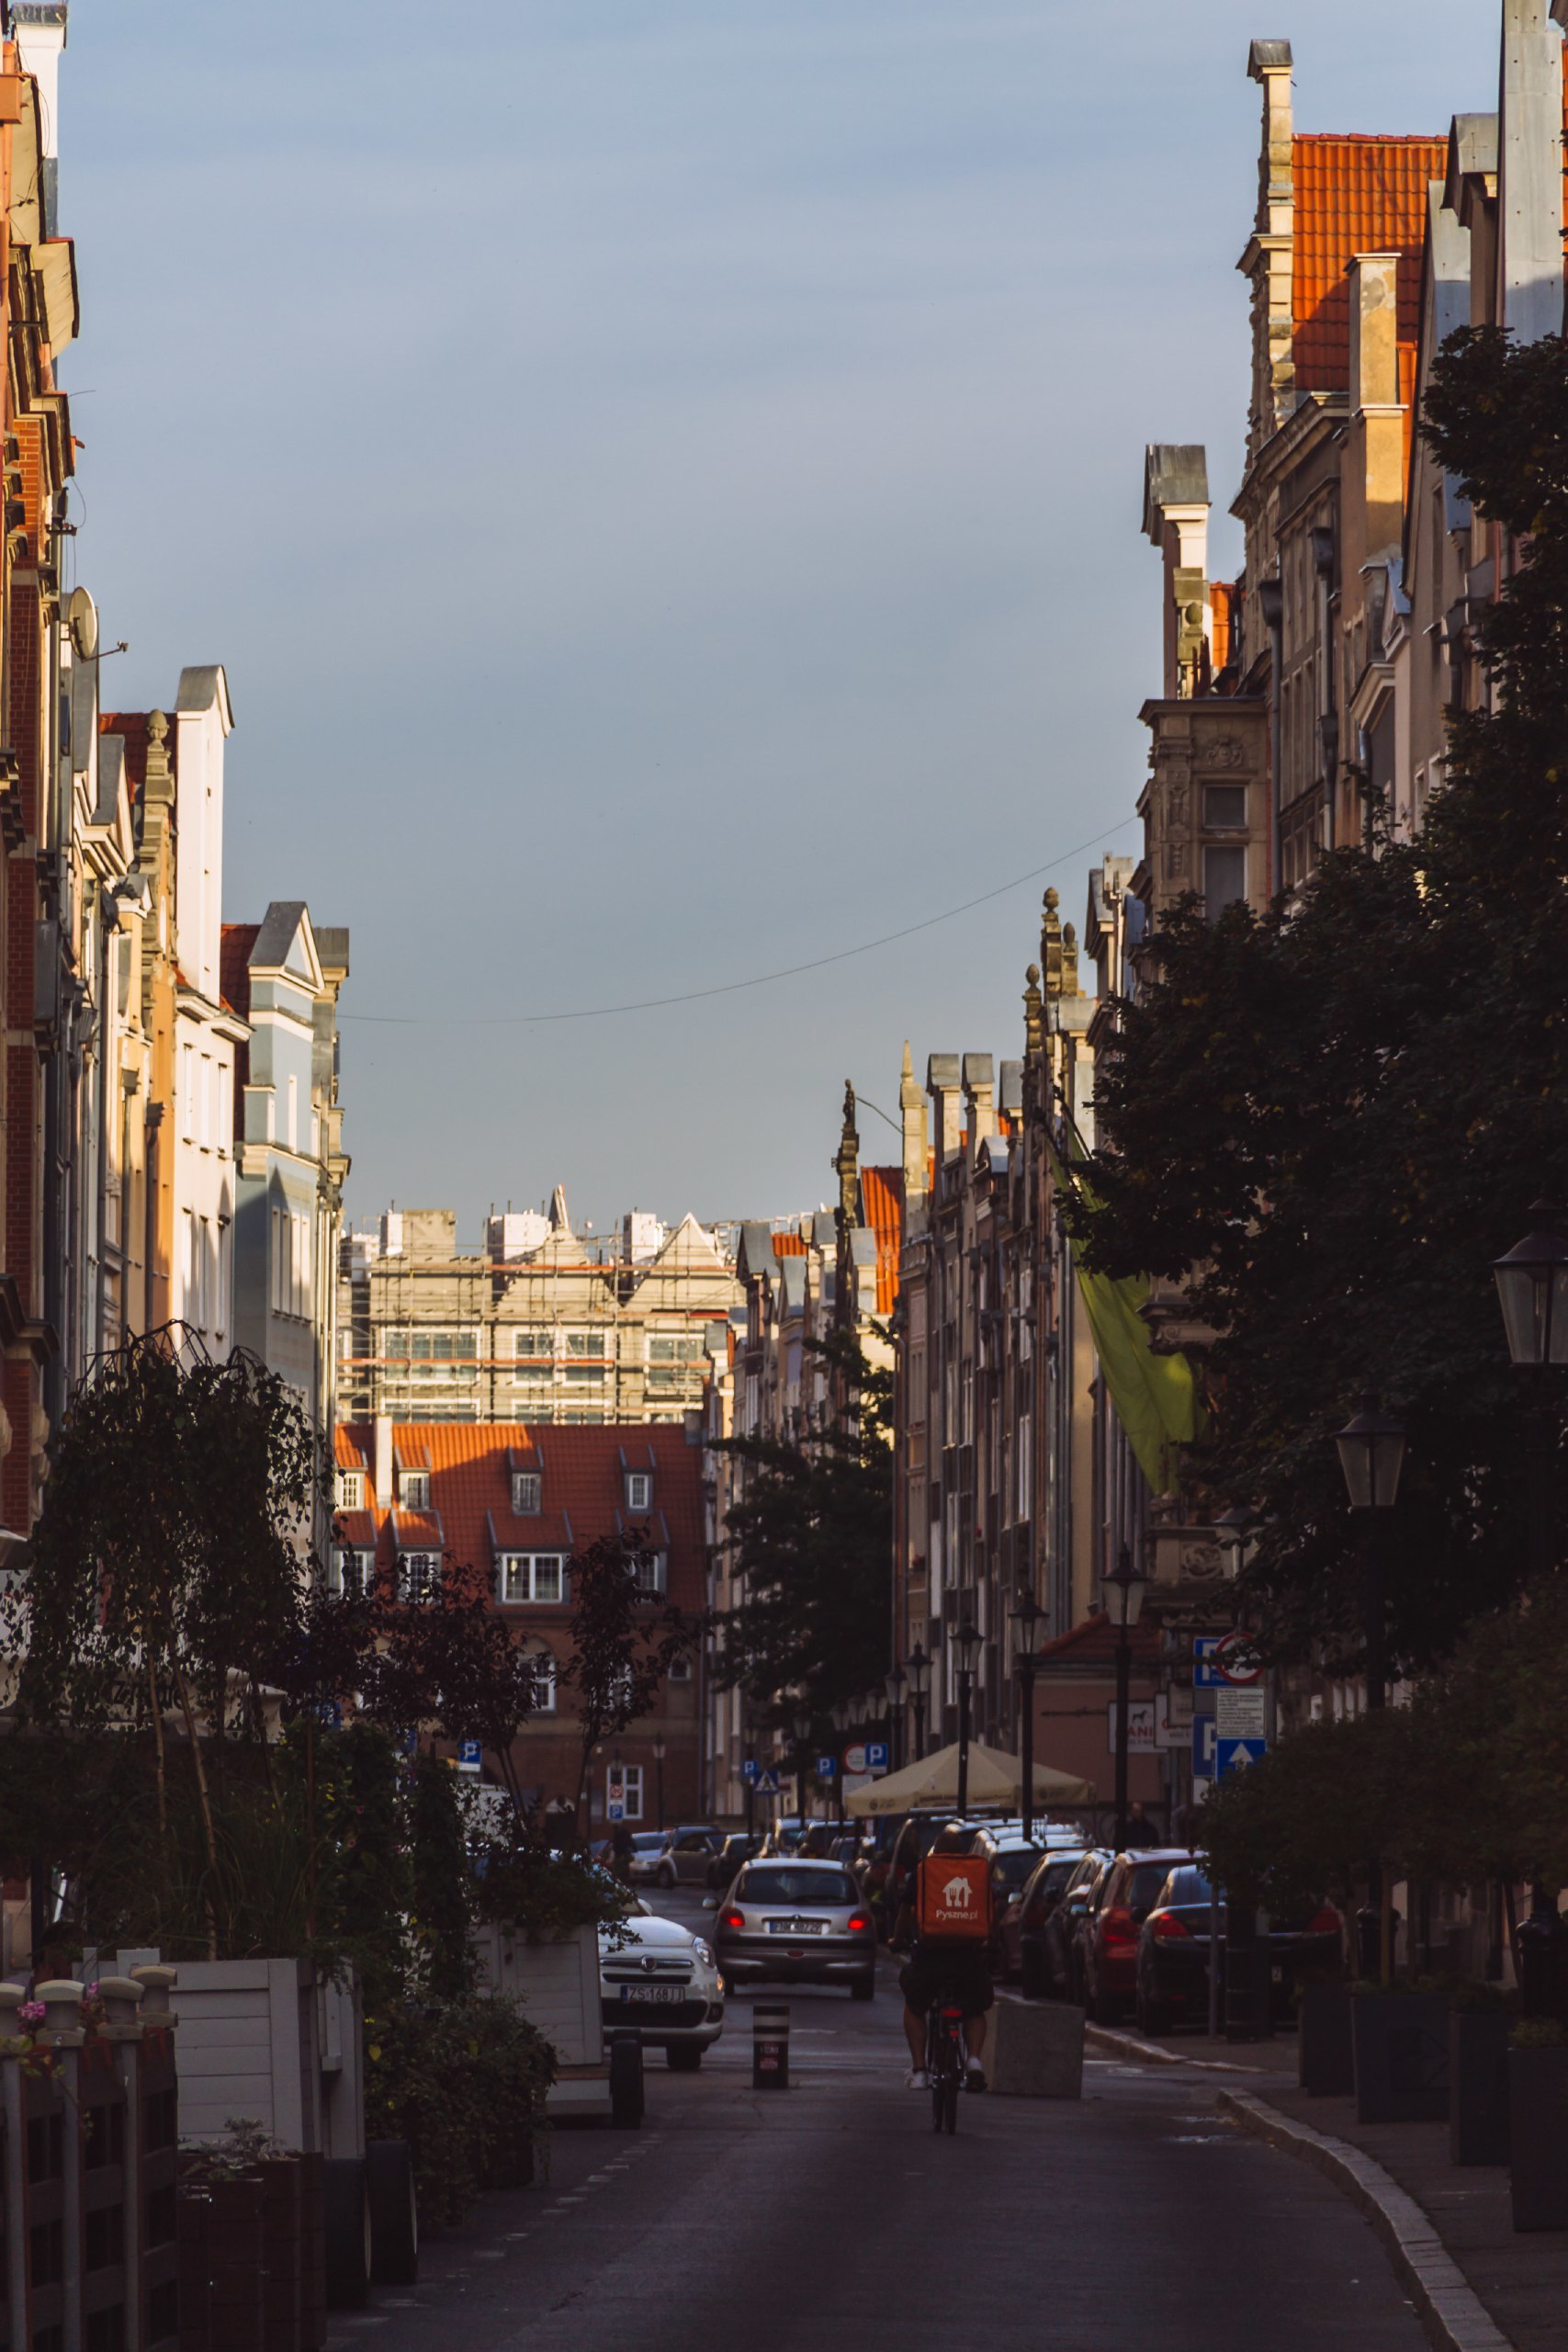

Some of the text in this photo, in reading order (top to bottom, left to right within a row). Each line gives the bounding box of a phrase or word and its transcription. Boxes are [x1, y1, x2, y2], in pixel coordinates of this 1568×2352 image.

[464, 1742, 478, 1759] P
[869, 1746, 883, 1763] P
[744, 1761, 754, 1773] P
[818, 1758, 830, 1772] P
[935, 1909, 978, 1920] Pyszne.pl
[629, 1987, 645, 2000] ZS
